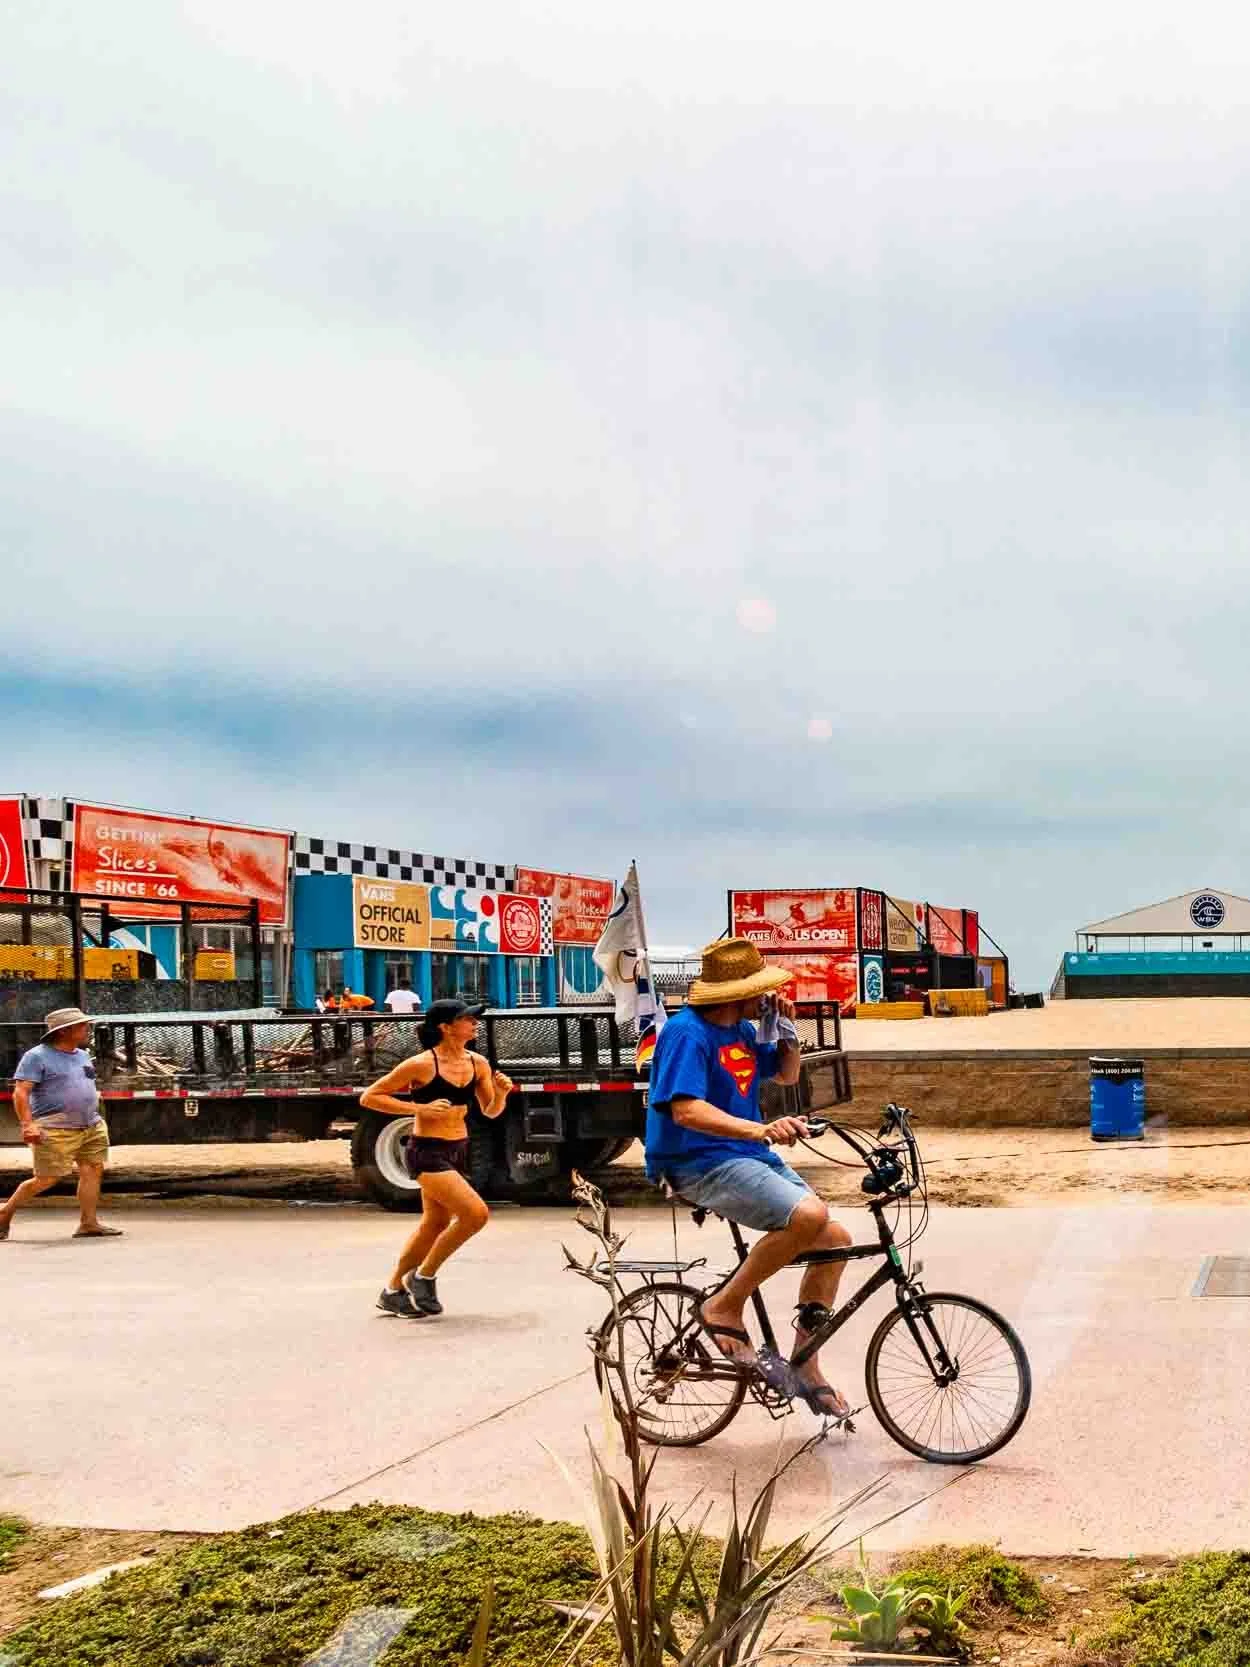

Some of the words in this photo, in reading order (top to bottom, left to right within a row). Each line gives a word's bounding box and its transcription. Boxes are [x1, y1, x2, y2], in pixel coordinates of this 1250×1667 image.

[98, 846, 158, 872] Slices
[96, 880, 145, 897] SINCE
[152, 883, 179, 897] '66
[360, 904, 422, 924] OFFICIAL
[361, 924, 406, 943] STORE
[742, 930, 771, 941] VANS
[795, 929, 810, 940] US
[811, 929, 845, 940] OPEN
